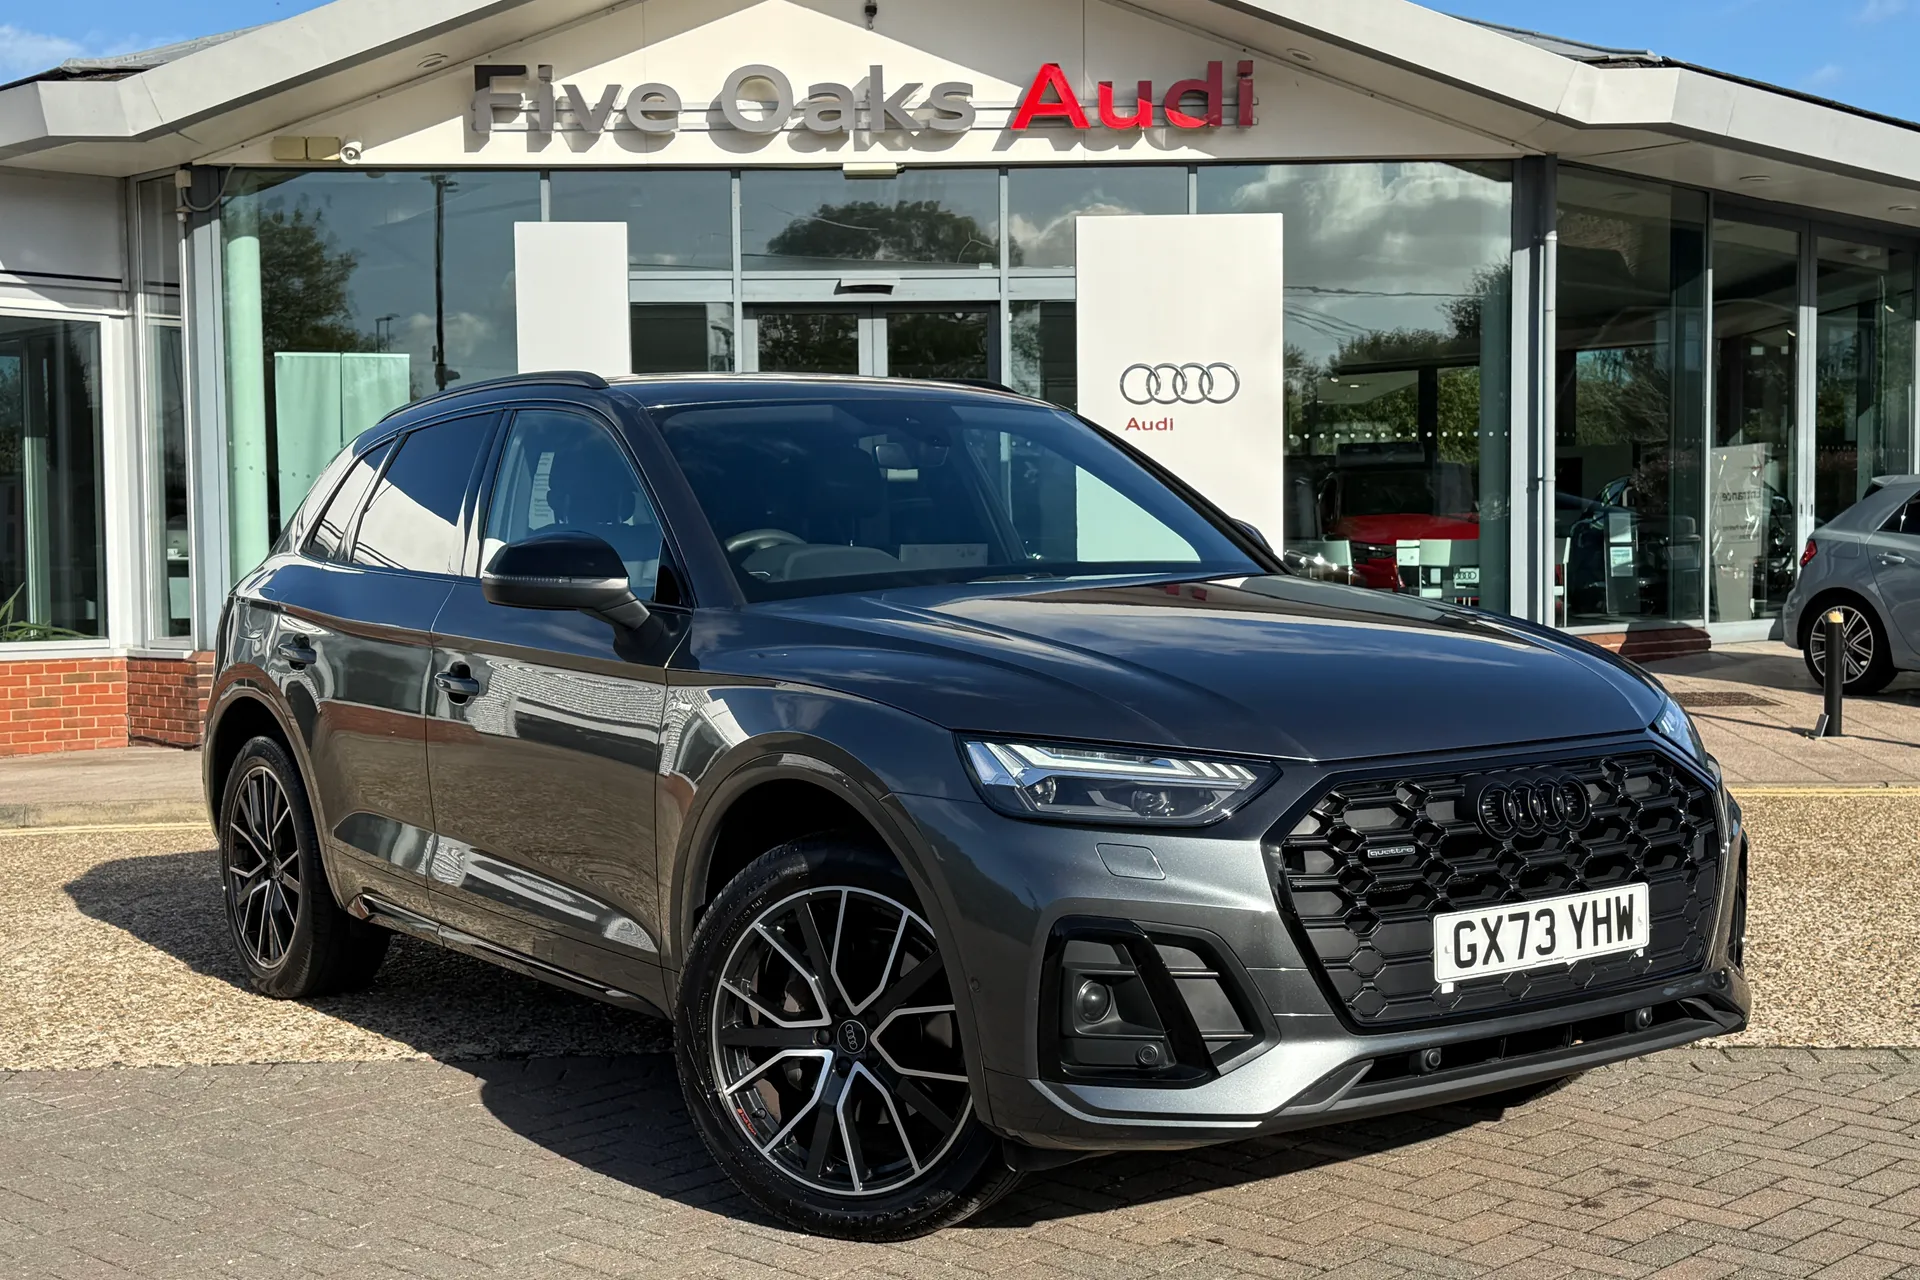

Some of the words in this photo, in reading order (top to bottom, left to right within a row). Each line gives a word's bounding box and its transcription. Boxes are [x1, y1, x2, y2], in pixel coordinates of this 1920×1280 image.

[474, 64, 682, 133] Five
[721, 64, 976, 133] Oaks
[1010, 60, 1254, 130] Audi
[1125, 417, 1174, 431] Audi
[1369, 847, 1414, 857] quattro
[1453, 908, 1557, 969] GX73
[1568, 894, 1635, 950] YHW
